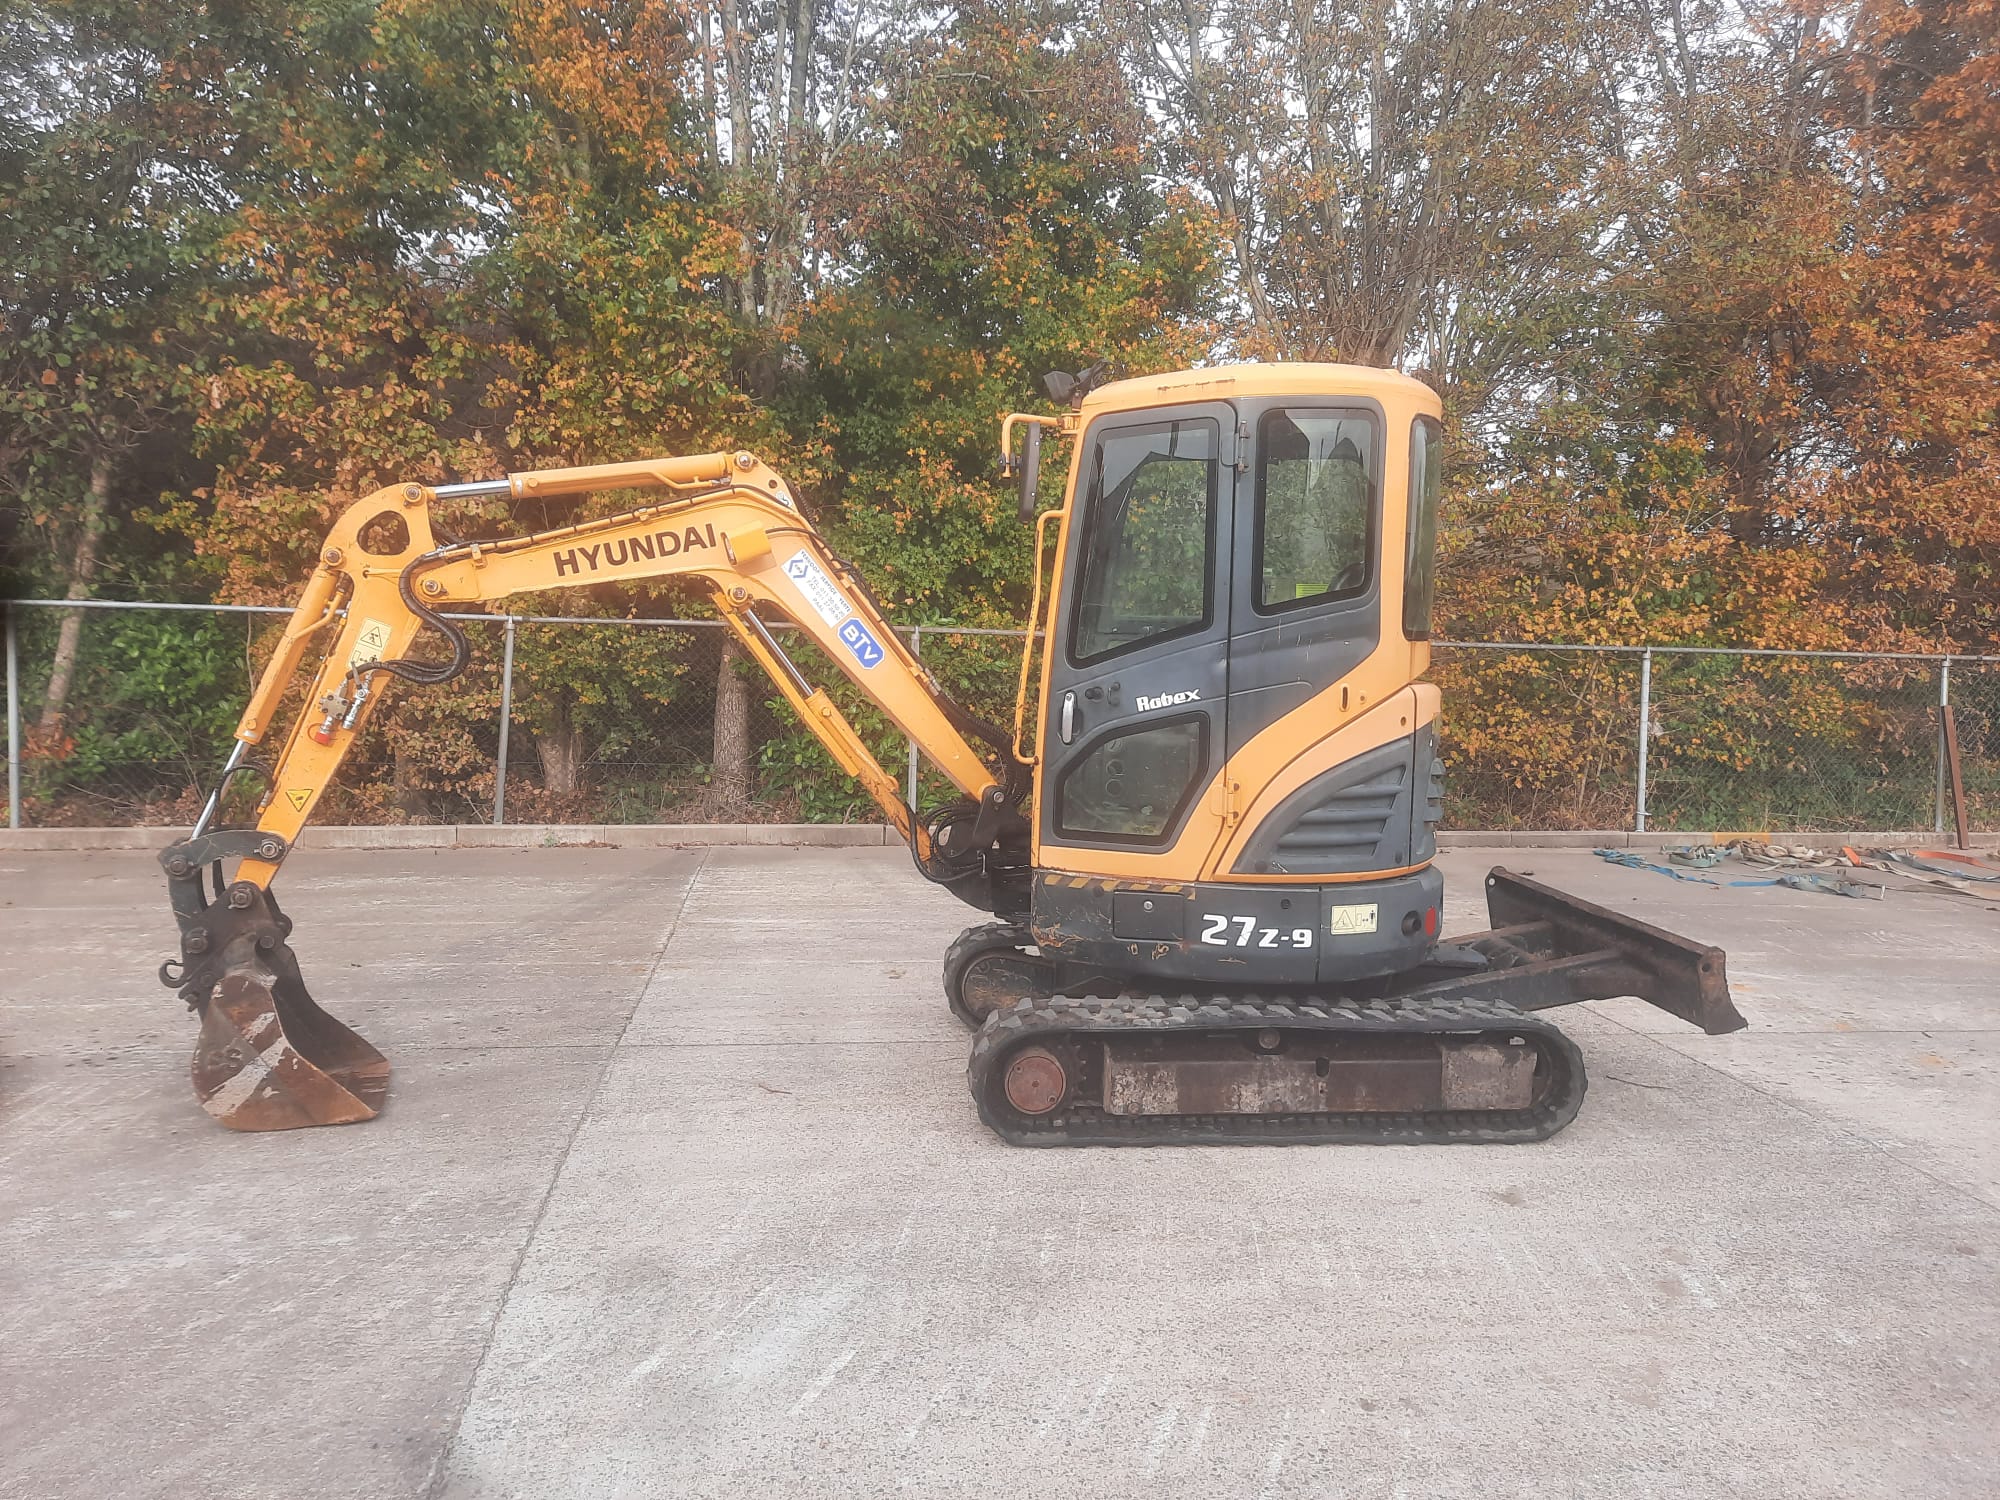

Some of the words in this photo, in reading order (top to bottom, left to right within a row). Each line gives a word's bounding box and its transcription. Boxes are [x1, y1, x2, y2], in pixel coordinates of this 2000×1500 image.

[553, 523, 717, 577] HYUNDAI
[843, 624, 879, 660] BTV
[1136, 688, 1201, 712] Robex
